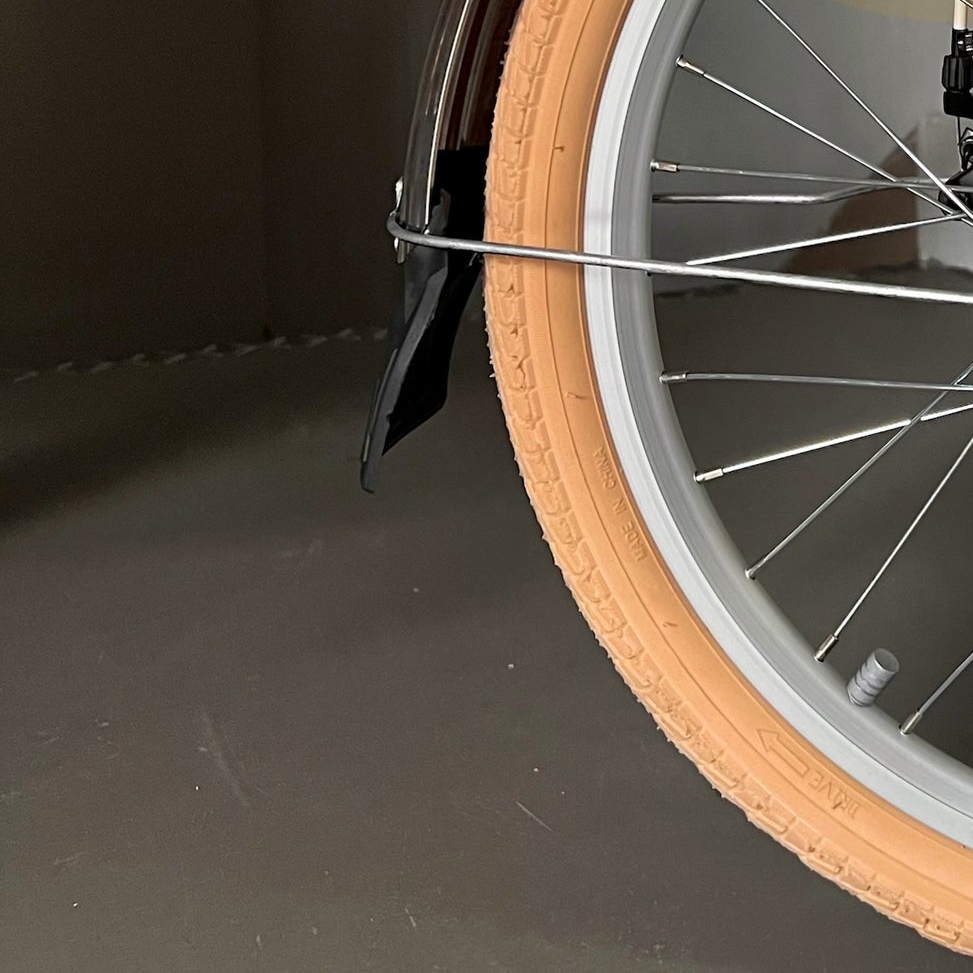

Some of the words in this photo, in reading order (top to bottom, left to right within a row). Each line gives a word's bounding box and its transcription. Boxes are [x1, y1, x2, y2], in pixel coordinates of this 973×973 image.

[593, 447, 617, 490] CHINA
[612, 498, 627, 515] IN
[622, 520, 649, 563] MADE
